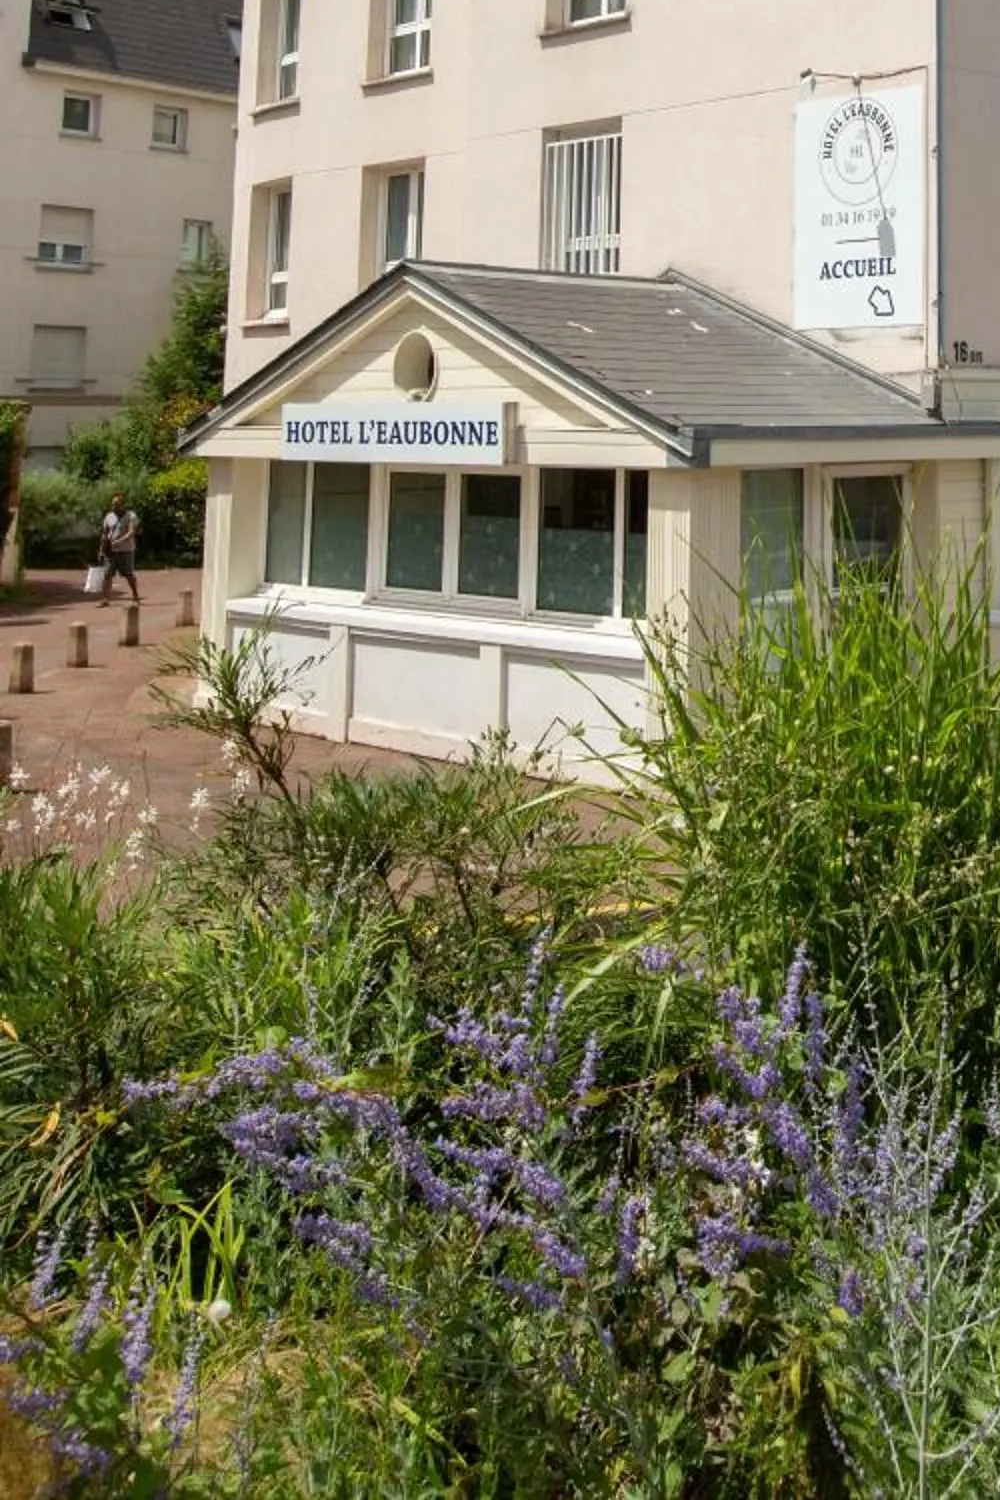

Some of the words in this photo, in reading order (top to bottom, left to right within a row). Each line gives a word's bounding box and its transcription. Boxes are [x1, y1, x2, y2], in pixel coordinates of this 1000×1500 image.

[823, 116, 843, 160] HOTEL
[819, 257, 897, 281] ACCUEIL
[285, 420, 353, 443] HOTEL
[359, 419, 499, 446] L'EAUBONNE
